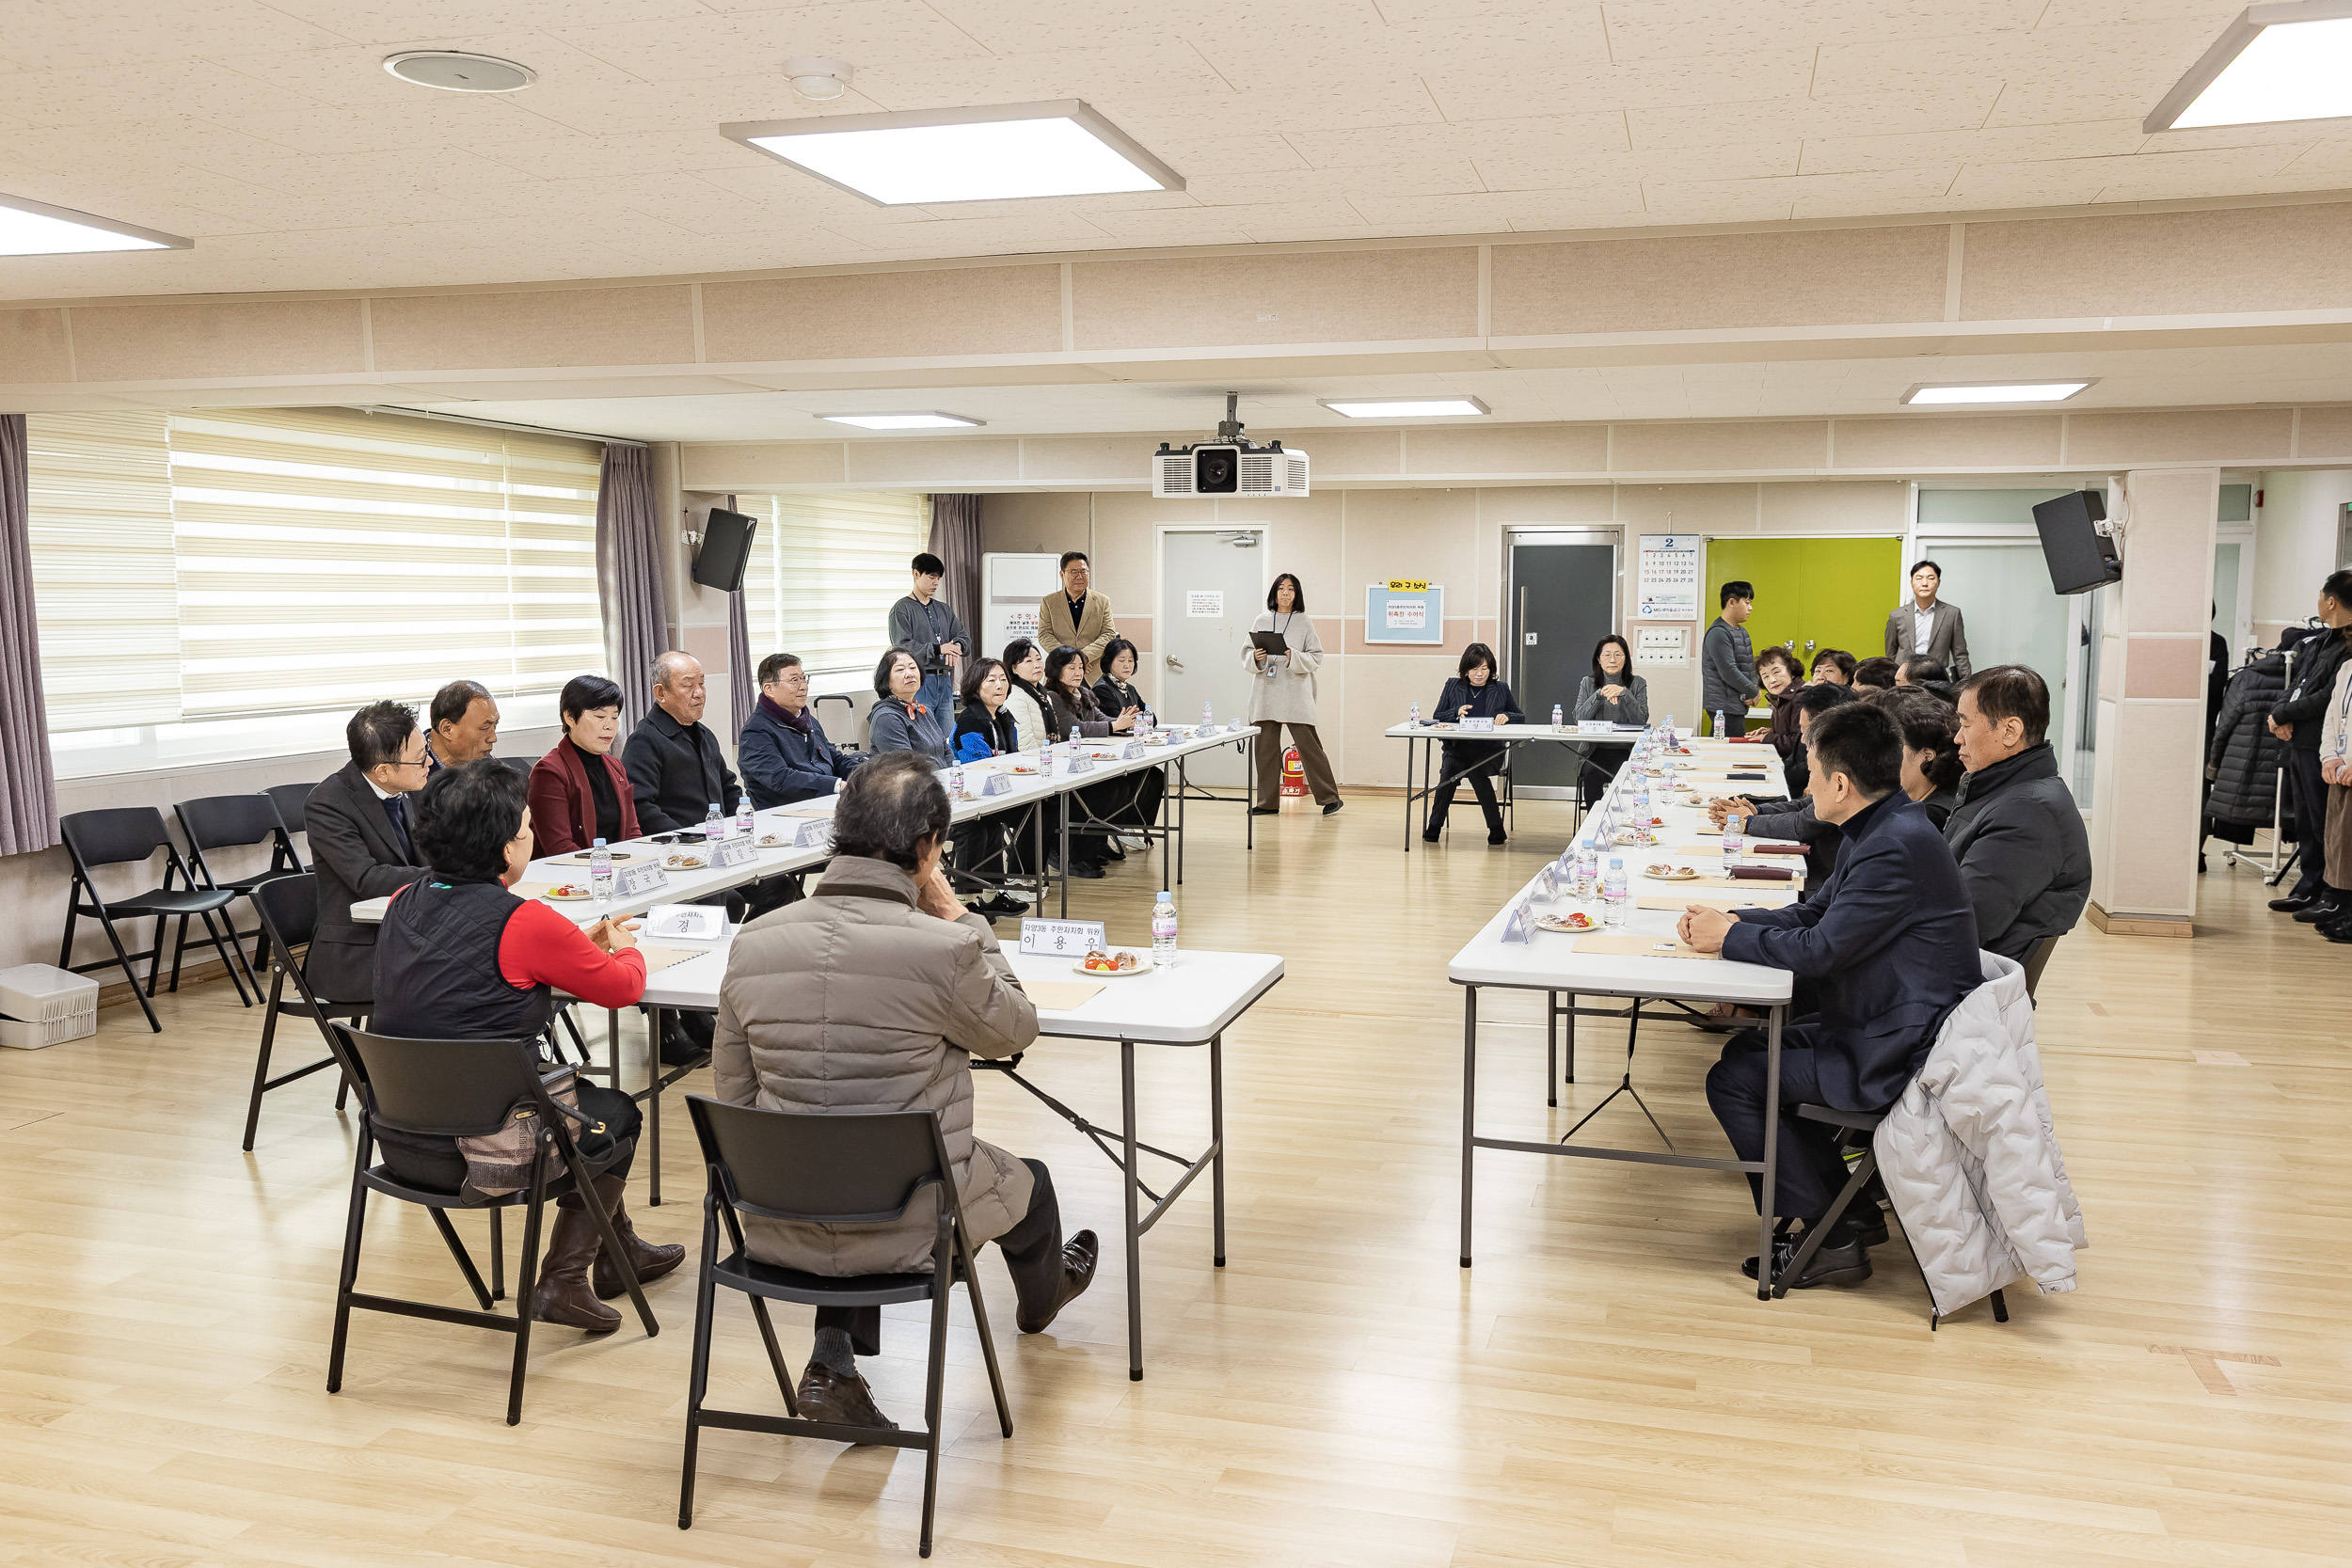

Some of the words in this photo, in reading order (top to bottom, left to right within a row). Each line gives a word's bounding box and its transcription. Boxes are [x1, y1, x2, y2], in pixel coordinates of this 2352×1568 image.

[1665, 538, 1674, 546] 2
[677, 919, 689, 933] 경
[1025, 924, 1047, 932] 자양3동
[1051, 926, 1083, 934] 주민자치회
[1024, 934, 1035, 949] 이
[1054, 936, 1067, 950] 용
